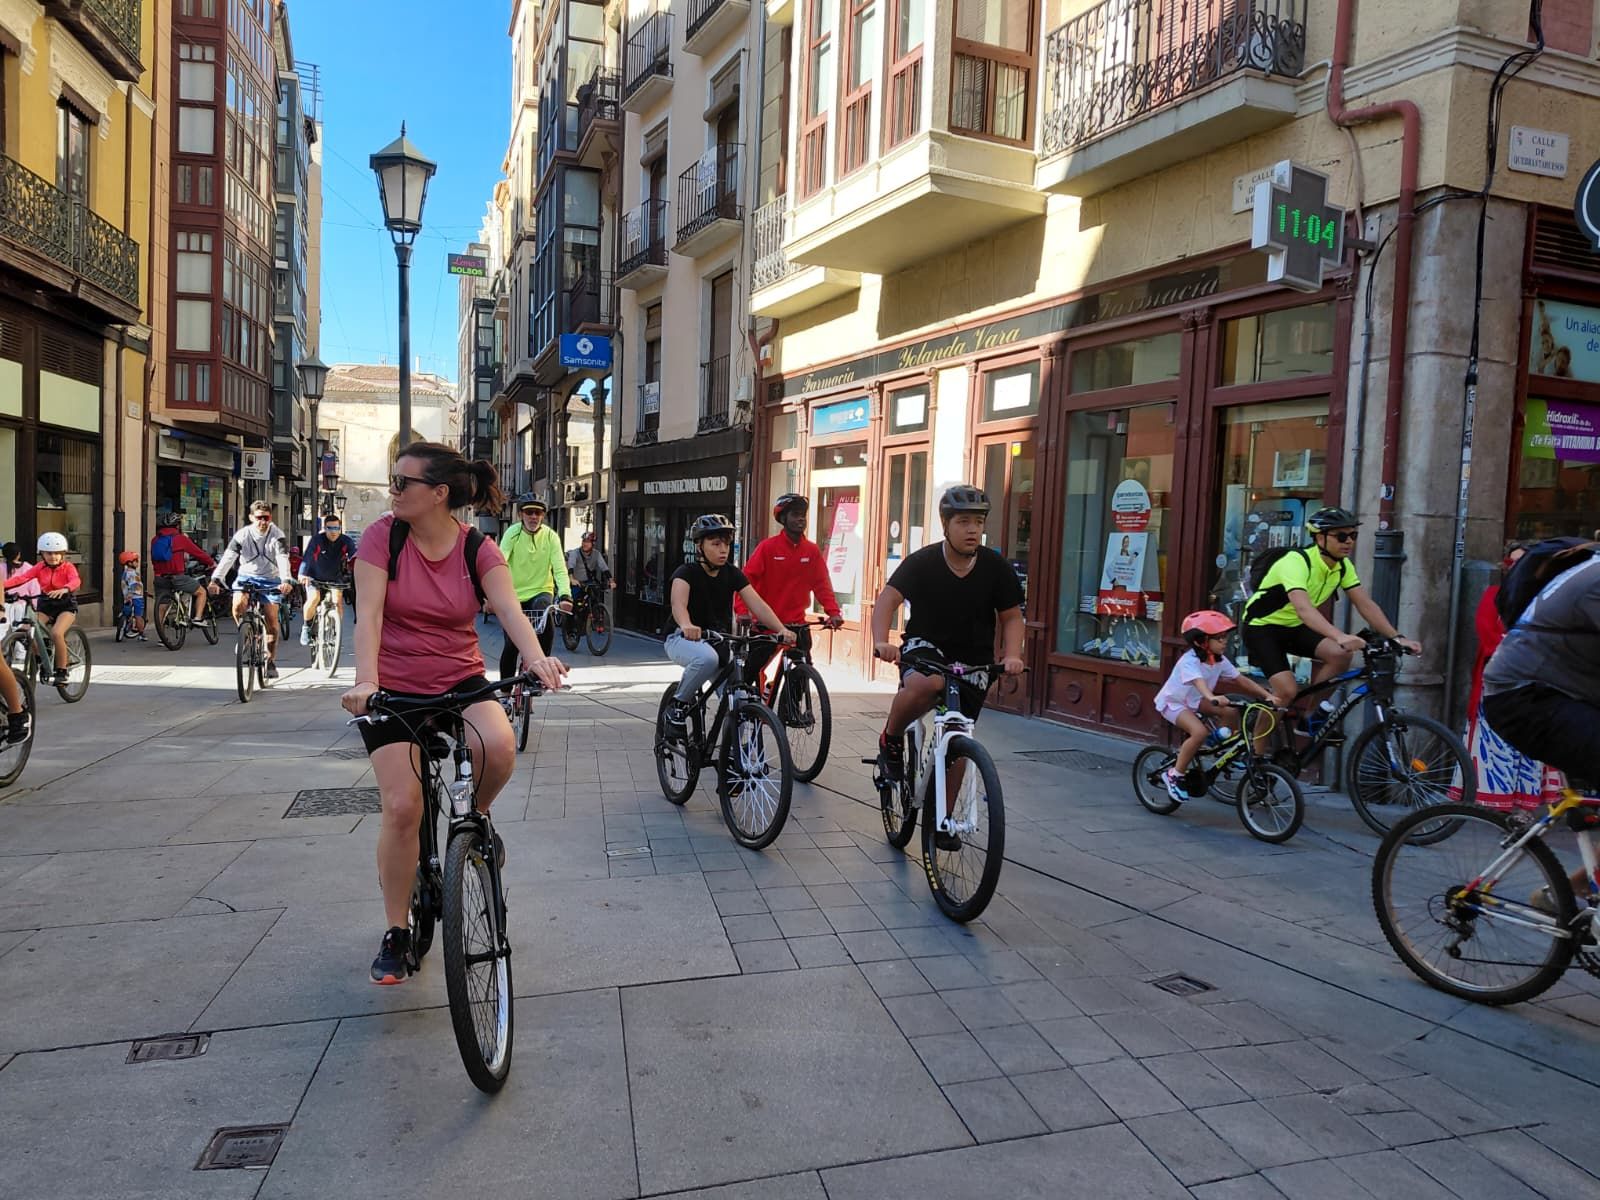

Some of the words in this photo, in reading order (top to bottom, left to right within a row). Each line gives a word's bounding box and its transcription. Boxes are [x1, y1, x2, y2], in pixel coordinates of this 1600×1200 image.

[1531, 135, 1555, 147] CALLE
[1535, 147, 1546, 157] DE
[1252, 169, 1275, 183] CALLE
[1277, 203, 1336, 250] 11:04
[451, 265, 483, 276] BOLSOS
[1566, 316, 1579, 332] Un
[898, 336, 966, 369] Yolanda
[973, 325, 1021, 350] Vara
[563, 356, 607, 367] Samsonite
[801, 367, 855, 392] Farmacia
[700, 475, 728, 492] WORLD
